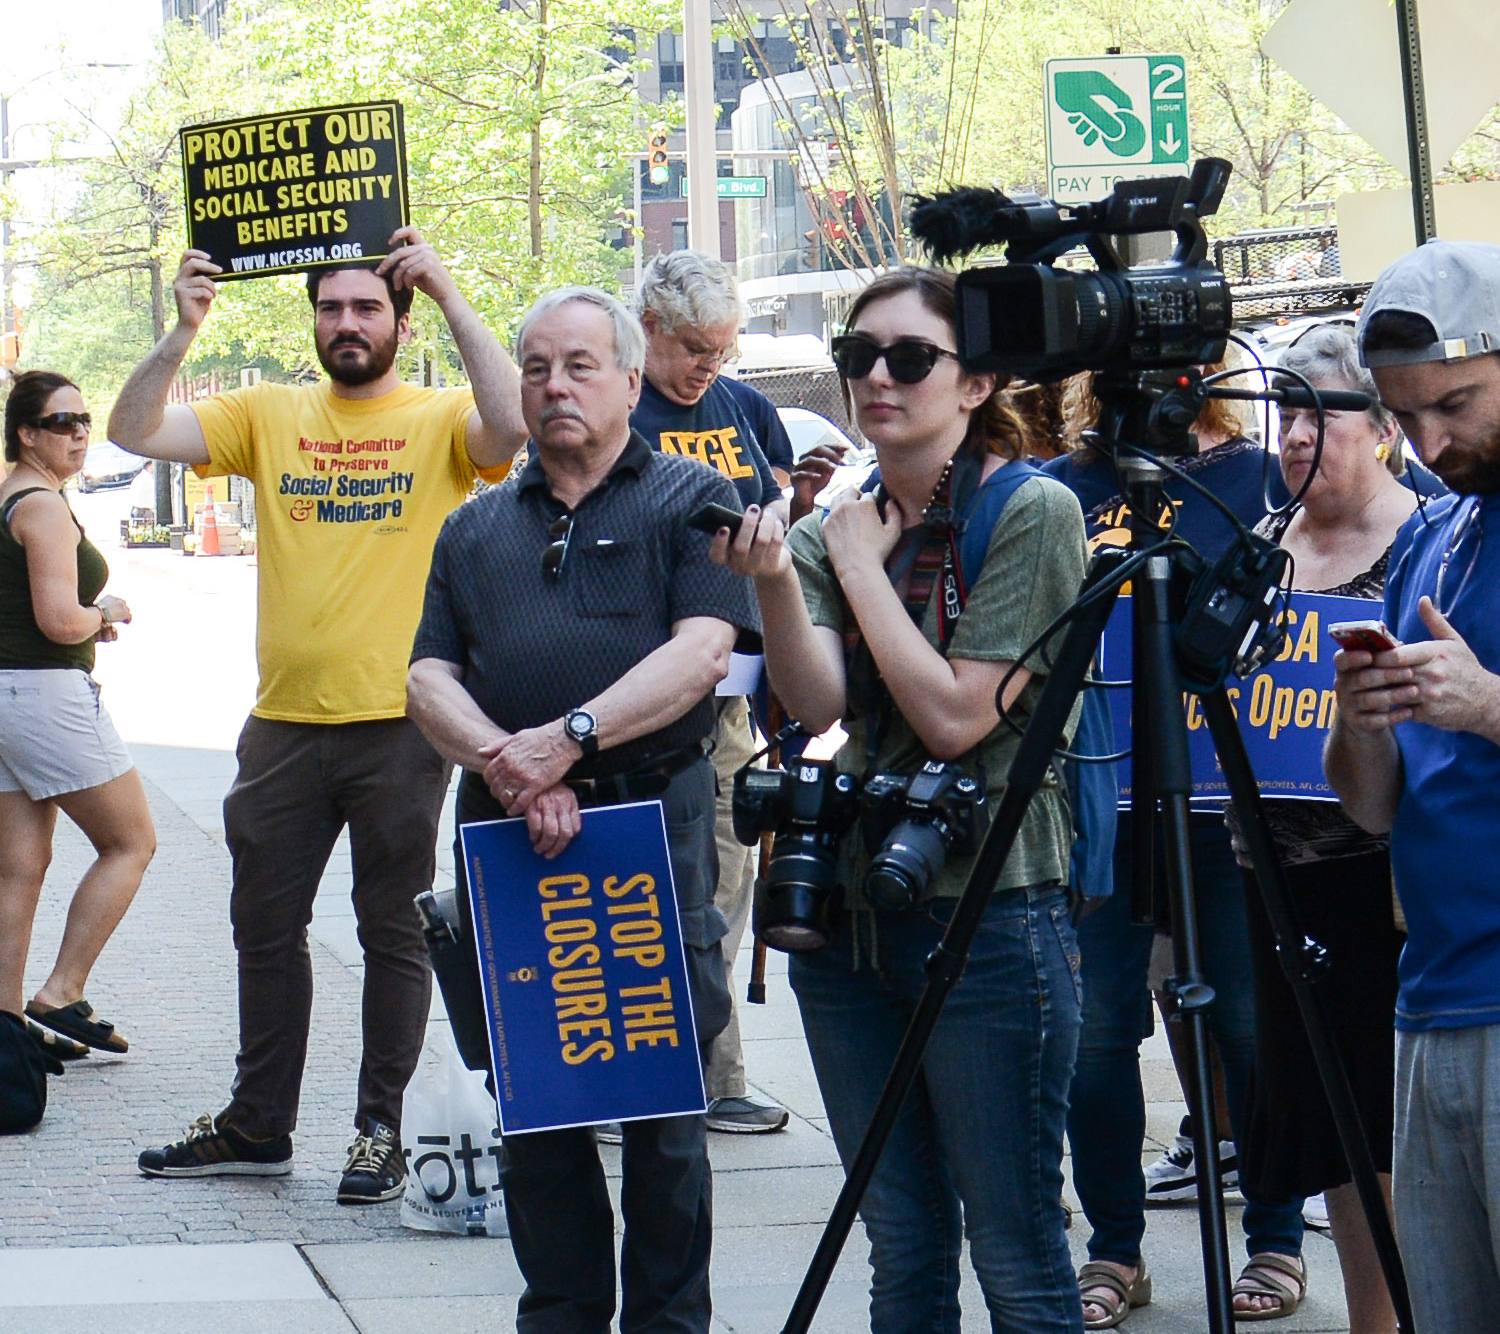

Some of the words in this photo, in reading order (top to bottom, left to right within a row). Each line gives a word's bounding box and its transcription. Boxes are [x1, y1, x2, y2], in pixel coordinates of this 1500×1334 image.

[1152, 63, 1185, 100] 2
[1156, 104, 1181, 112] HOUR
[186, 117, 311, 165] PROTECT
[324, 110, 393, 145] OUR
[203, 152, 316, 191] MEDICARE
[325, 147, 377, 174] AND
[731, 181, 761, 193] Blvd.
[1057, 176, 1092, 193] PAY
[193, 189, 270, 222] SOCIAL
[276, 174, 393, 210] SECURITY
[237, 208, 349, 245] BENEFITS
[230, 243, 363, 272] WWW.NCPSSM.ORG
[1200, 280, 1221, 288] SONY
[313, 456, 326, 472] to
[279, 472, 333, 496] Social
[336, 472, 414, 497] Security
[290, 499, 314, 522] &
[317, 498, 403, 523] Medicare
[945, 574, 960, 619] EOS
[1249, 673, 1338, 740] Open
[473, 856, 486, 900] AMERICAN
[479, 900, 493, 950] FEDERATION
[603, 872, 666, 968] STOP
[538, 872, 616, 1065] CLOSURES
[619, 976, 680, 1052] THE
